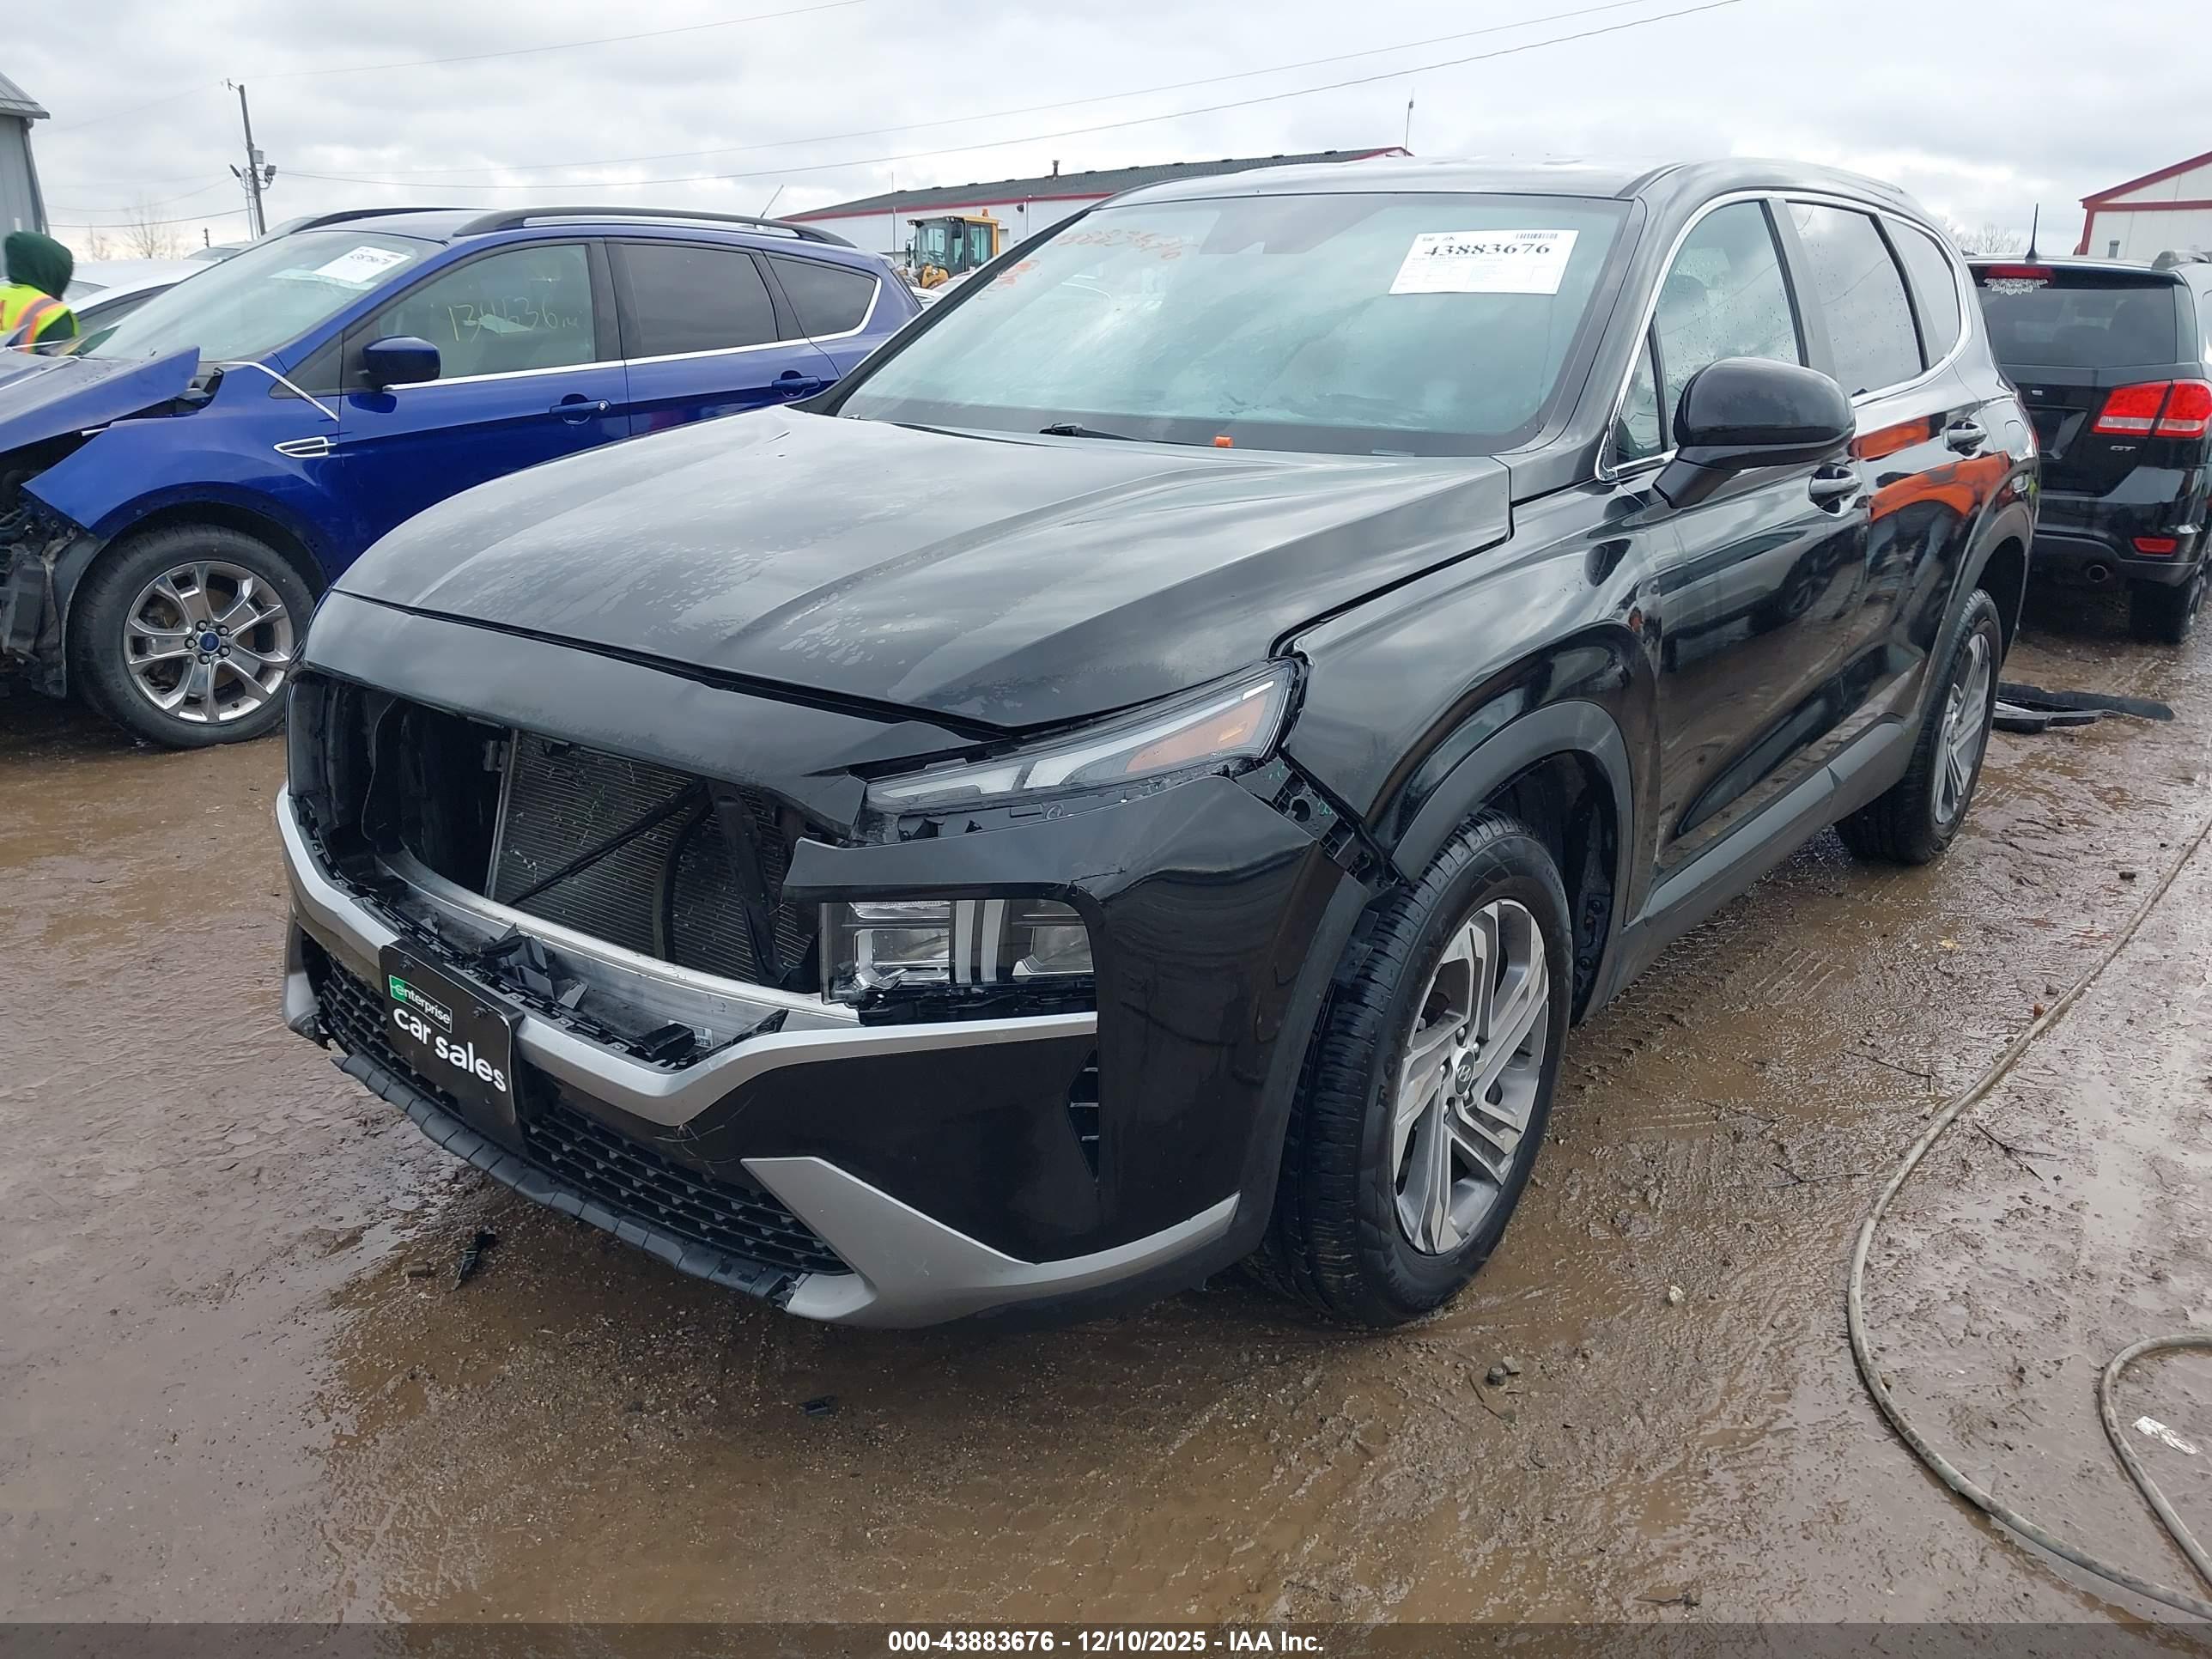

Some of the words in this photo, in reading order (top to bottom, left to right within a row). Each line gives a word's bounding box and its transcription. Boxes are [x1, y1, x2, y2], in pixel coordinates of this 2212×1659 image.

[1424, 242, 1551, 257] 43883676
[393, 983, 452, 1024] enterprise
[392, 1008, 432, 1045] car
[434, 1036, 507, 1092] sales
